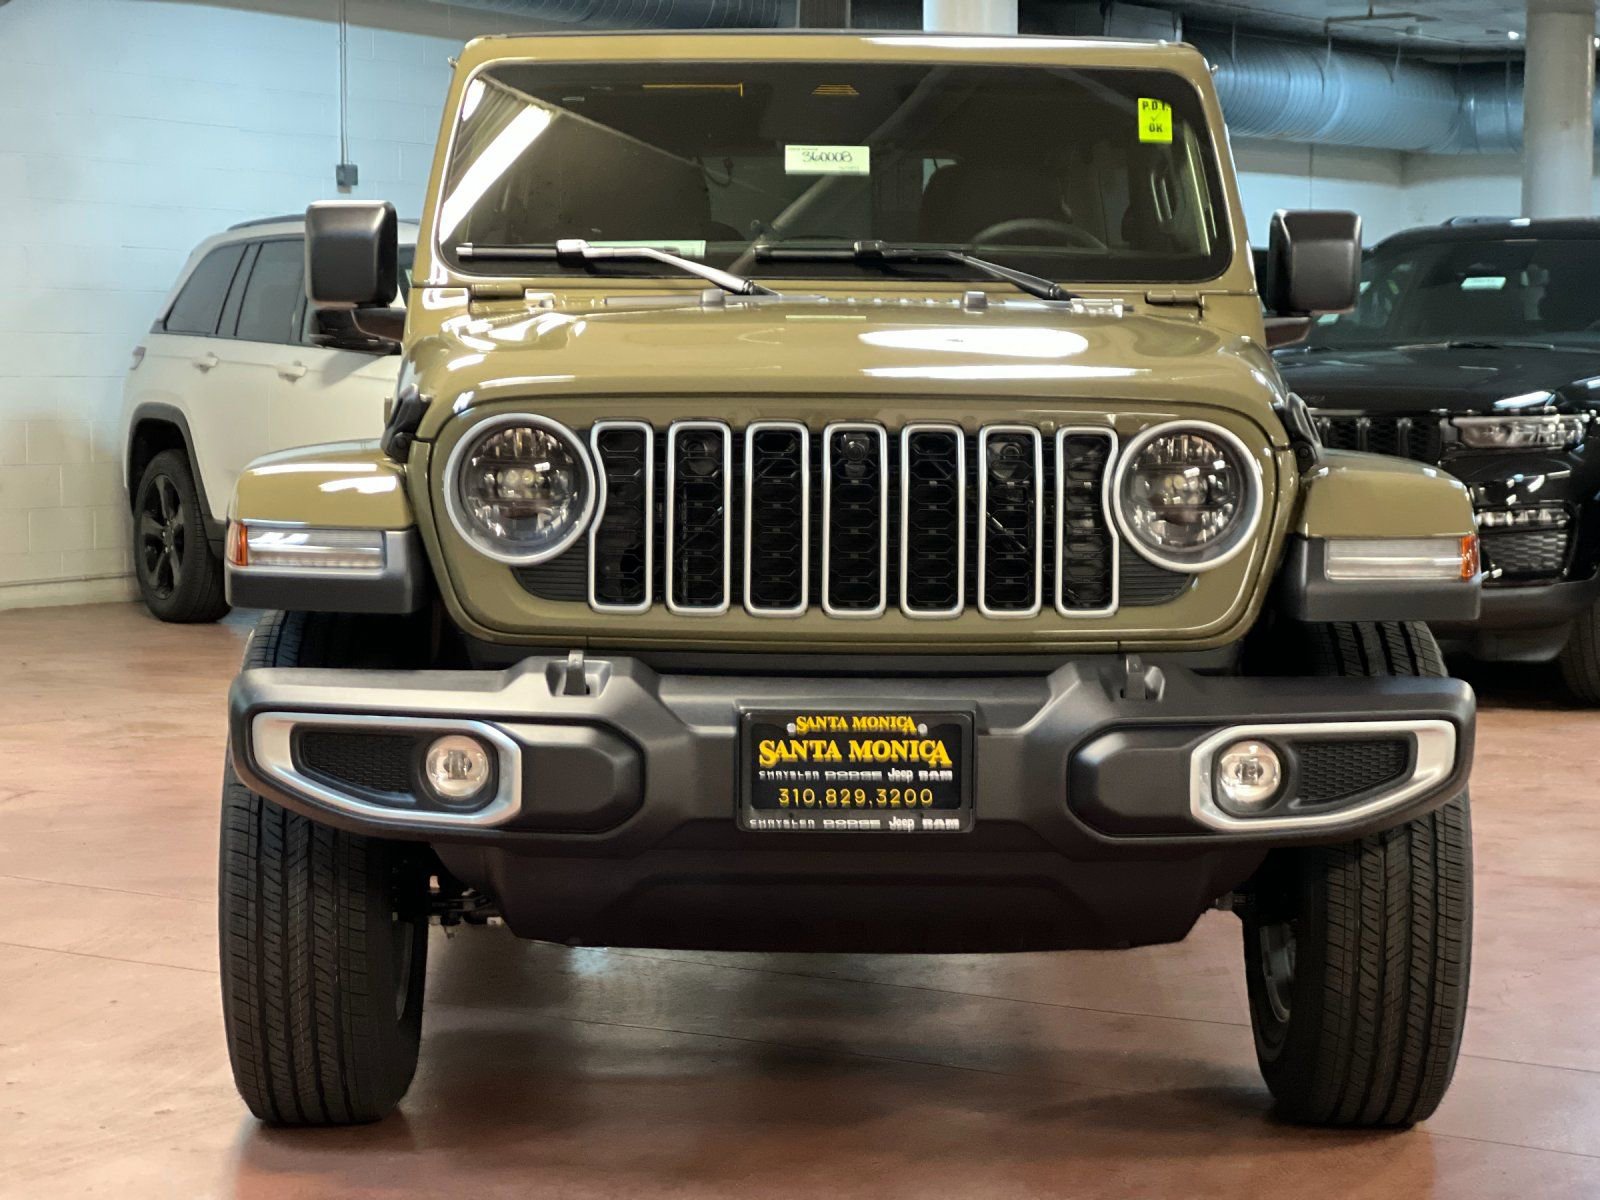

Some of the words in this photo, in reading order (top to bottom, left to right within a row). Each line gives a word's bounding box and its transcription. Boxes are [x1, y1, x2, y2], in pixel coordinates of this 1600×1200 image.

[1149, 123, 1163, 132] OK
[796, 716, 849, 734] SANTA
[852, 716, 917, 735] MONICA
[759, 740, 843, 767] SANTA
[849, 740, 952, 767] MONICA
[758, 770, 820, 780] CHRYSLER
[825, 770, 882, 780] DODGE
[887, 768, 913, 782] Jeep
[918, 770, 953, 780] RAM
[750, 819, 815, 829] CHRYSLER
[823, 819, 881, 829] DODGE
[889, 816, 915, 831] Jeep
[922, 818, 959, 829] RAM
